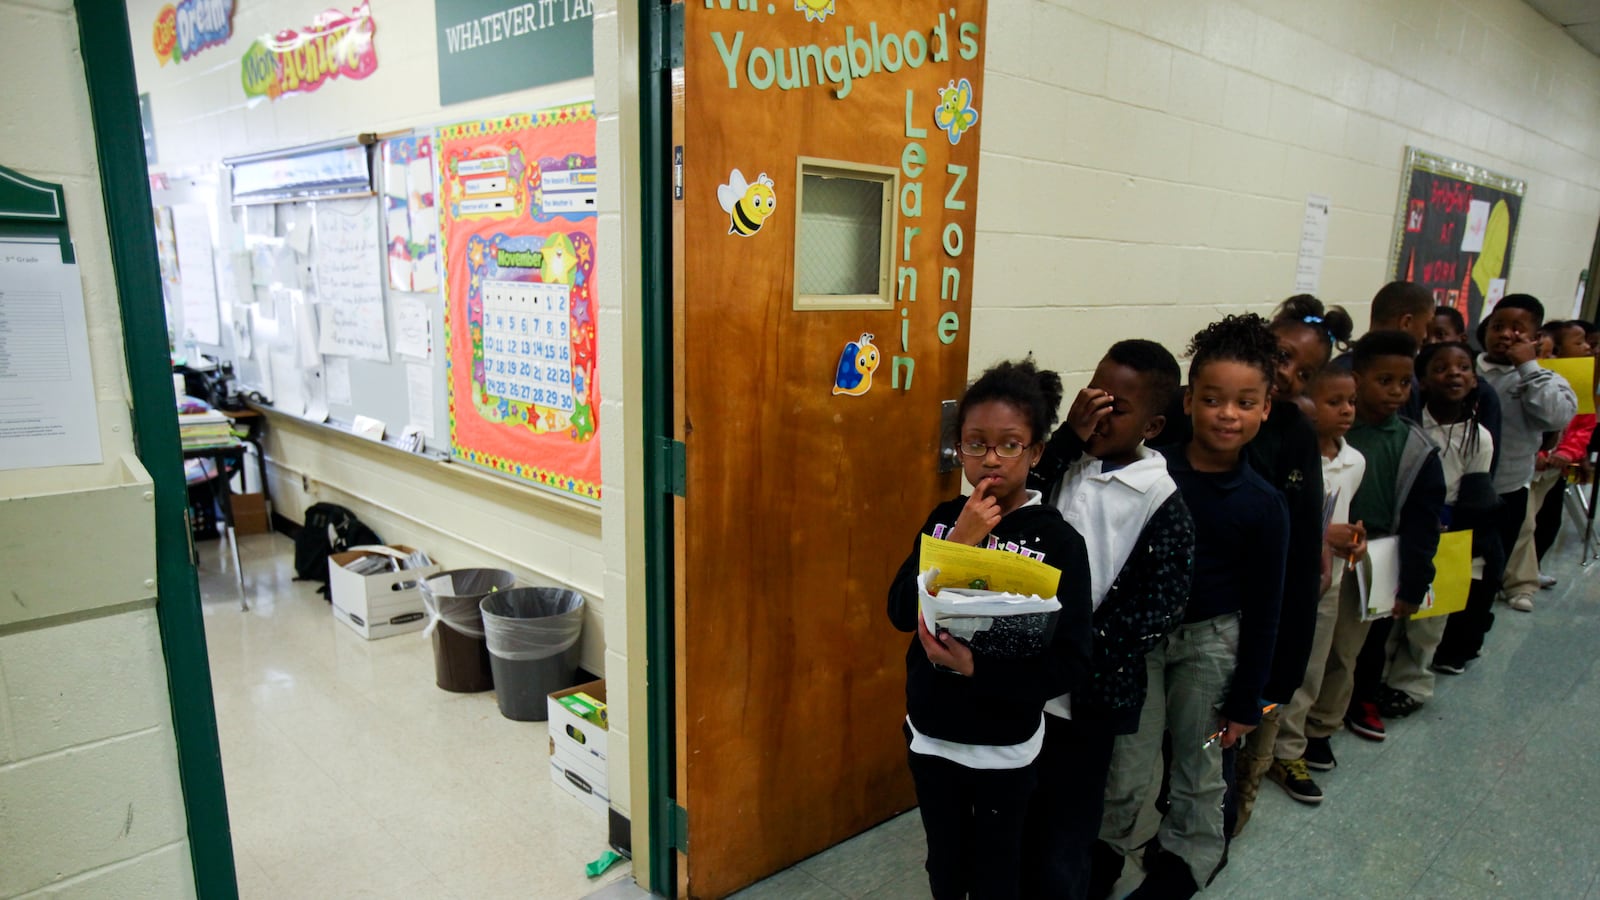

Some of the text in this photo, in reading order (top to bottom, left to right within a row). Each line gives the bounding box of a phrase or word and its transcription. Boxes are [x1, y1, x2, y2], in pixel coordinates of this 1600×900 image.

[177, 0, 226, 53] Dream
[446, 4, 537, 53] WHATEVER
[539, 0, 555, 30] IT
[244, 49, 278, 87] Work
[281, 25, 361, 92] Achieve
[711, 8, 979, 99] Youngblood's
[891, 89, 927, 391] Learnin
[938, 164, 968, 344] Zone
[497, 248, 543, 269] November
[1423, 260, 1457, 283] WORK
[547, 296, 565, 311] 1 2
[485, 313, 566, 336] 3 4 5 6 7 8 9
[485, 337, 568, 360] 10 11 12 13 14 15 16
[485, 358, 570, 384] 17 18 19 20 21 22 23
[488, 379, 572, 409] 24 25 26 27 28 29 30
